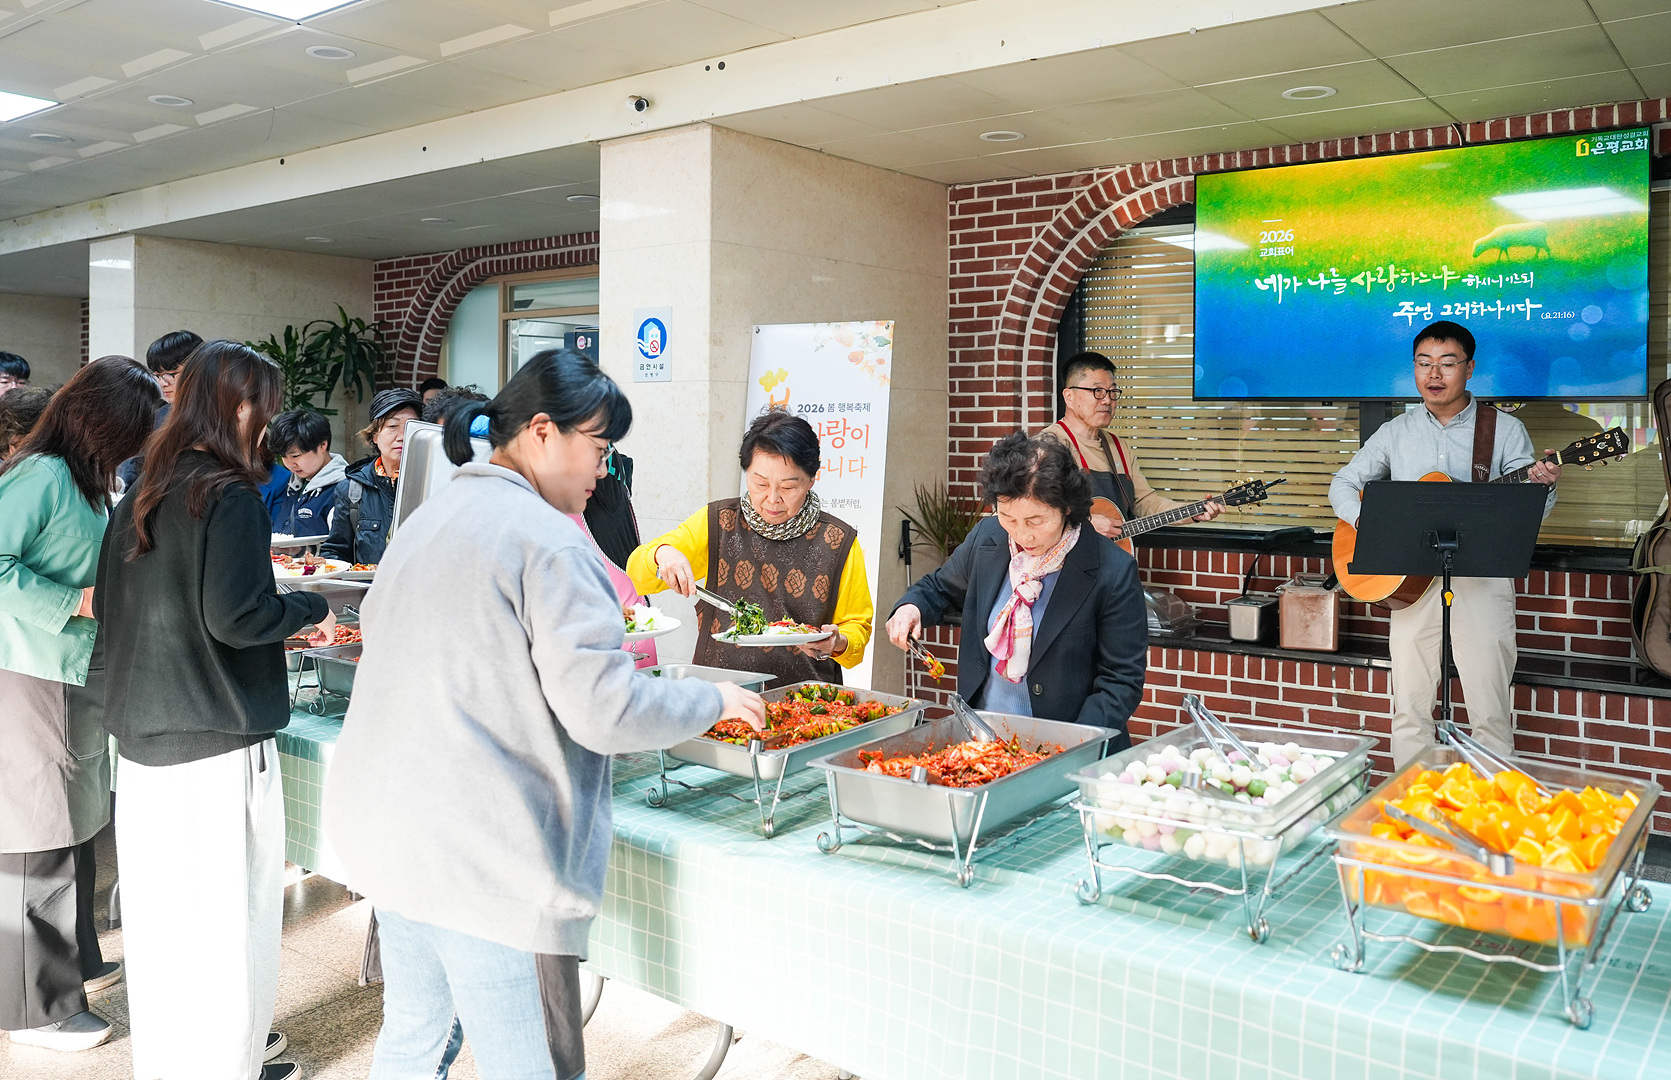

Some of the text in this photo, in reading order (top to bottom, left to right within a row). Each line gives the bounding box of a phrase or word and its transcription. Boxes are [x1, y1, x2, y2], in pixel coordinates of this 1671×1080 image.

[1591, 130, 1649, 142] 기독교대한성결교회
[1590, 138, 1649, 155] 은평교회
[1259, 229, 1294, 244] 2026
[1259, 246, 1294, 257] 교회표어
[1254, 264, 1534, 304] 네가 나를 사랑하느냐 하시니 이르되
[1392, 301, 1434, 326] 주님
[1440, 298, 1543, 321] 그러하나이다
[639, 363, 665, 371] 금연시설
[797, 402, 871, 413] 2026 봄 행복축제
[830, 498, 862, 509] 봄볕처럼,
